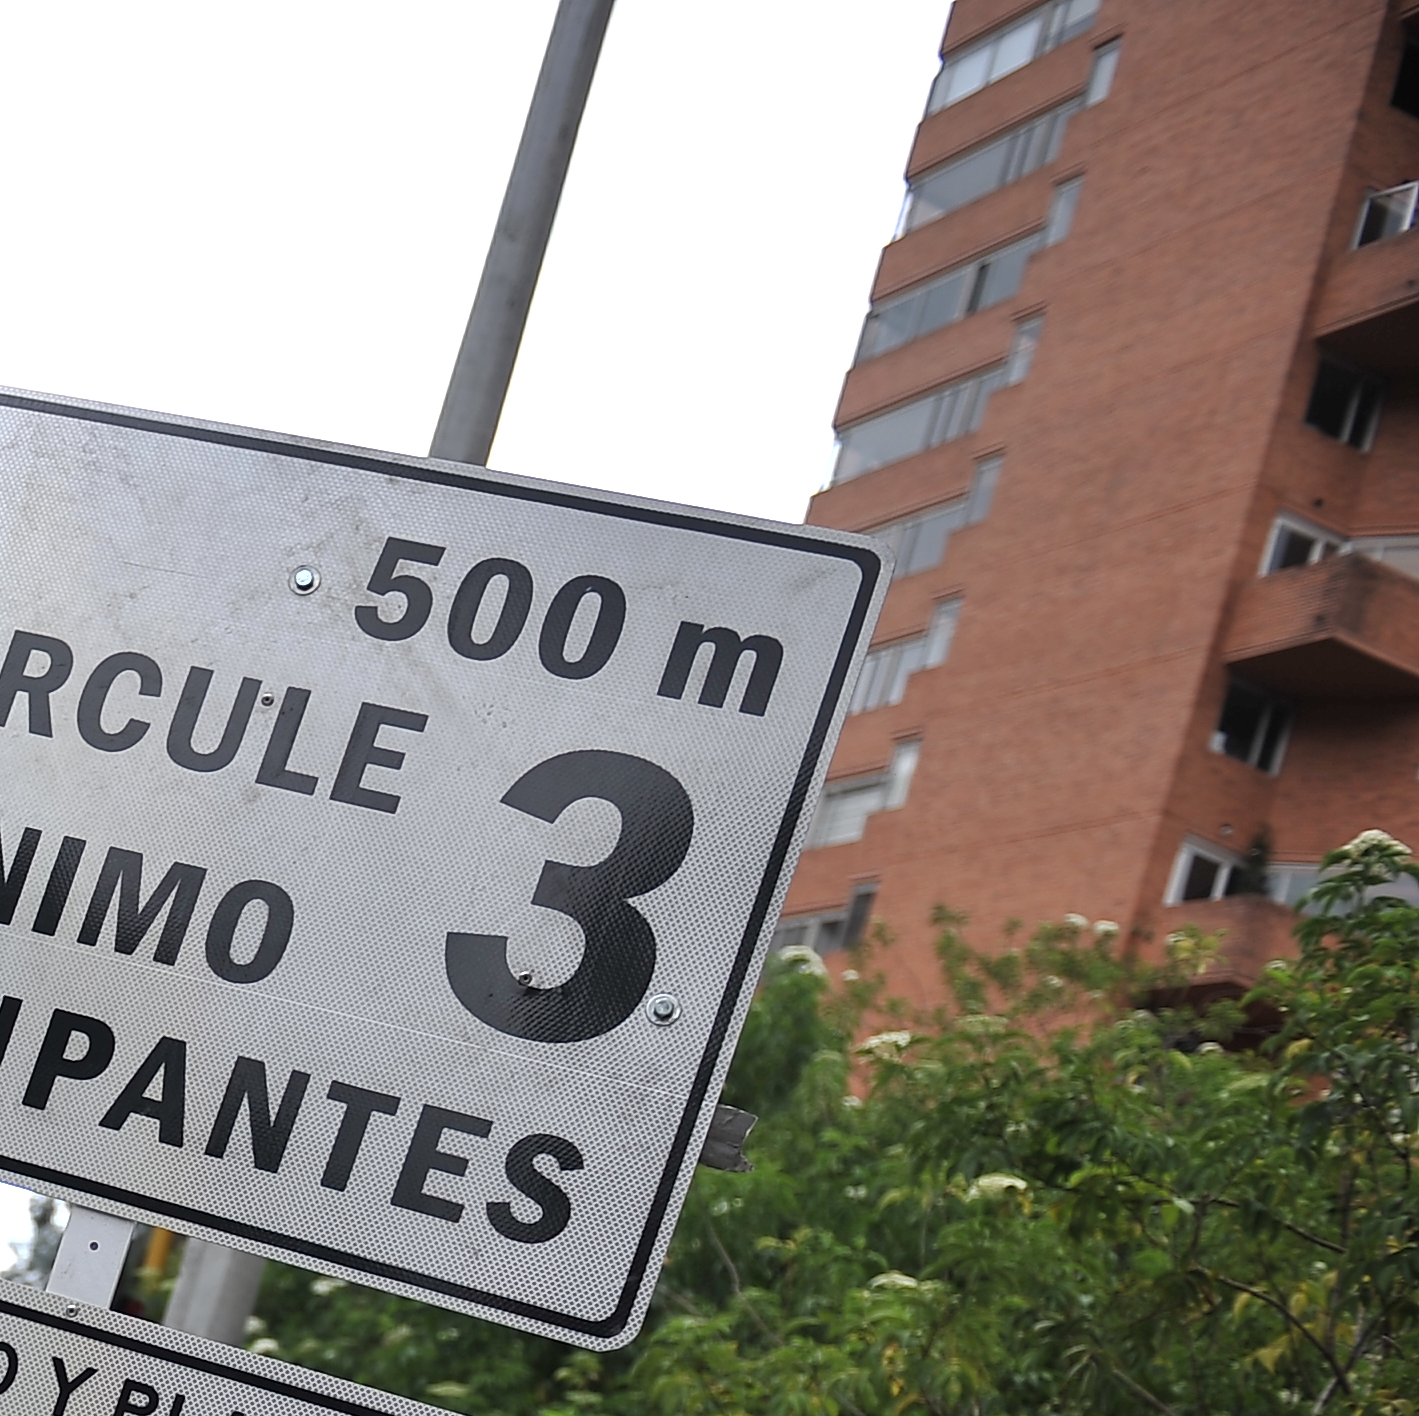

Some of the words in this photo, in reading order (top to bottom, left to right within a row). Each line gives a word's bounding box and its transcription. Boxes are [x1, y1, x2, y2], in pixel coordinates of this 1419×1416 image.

[353, 536, 628, 680] 500
[657, 618, 785, 718] m
[444, 748, 696, 1045] 3
